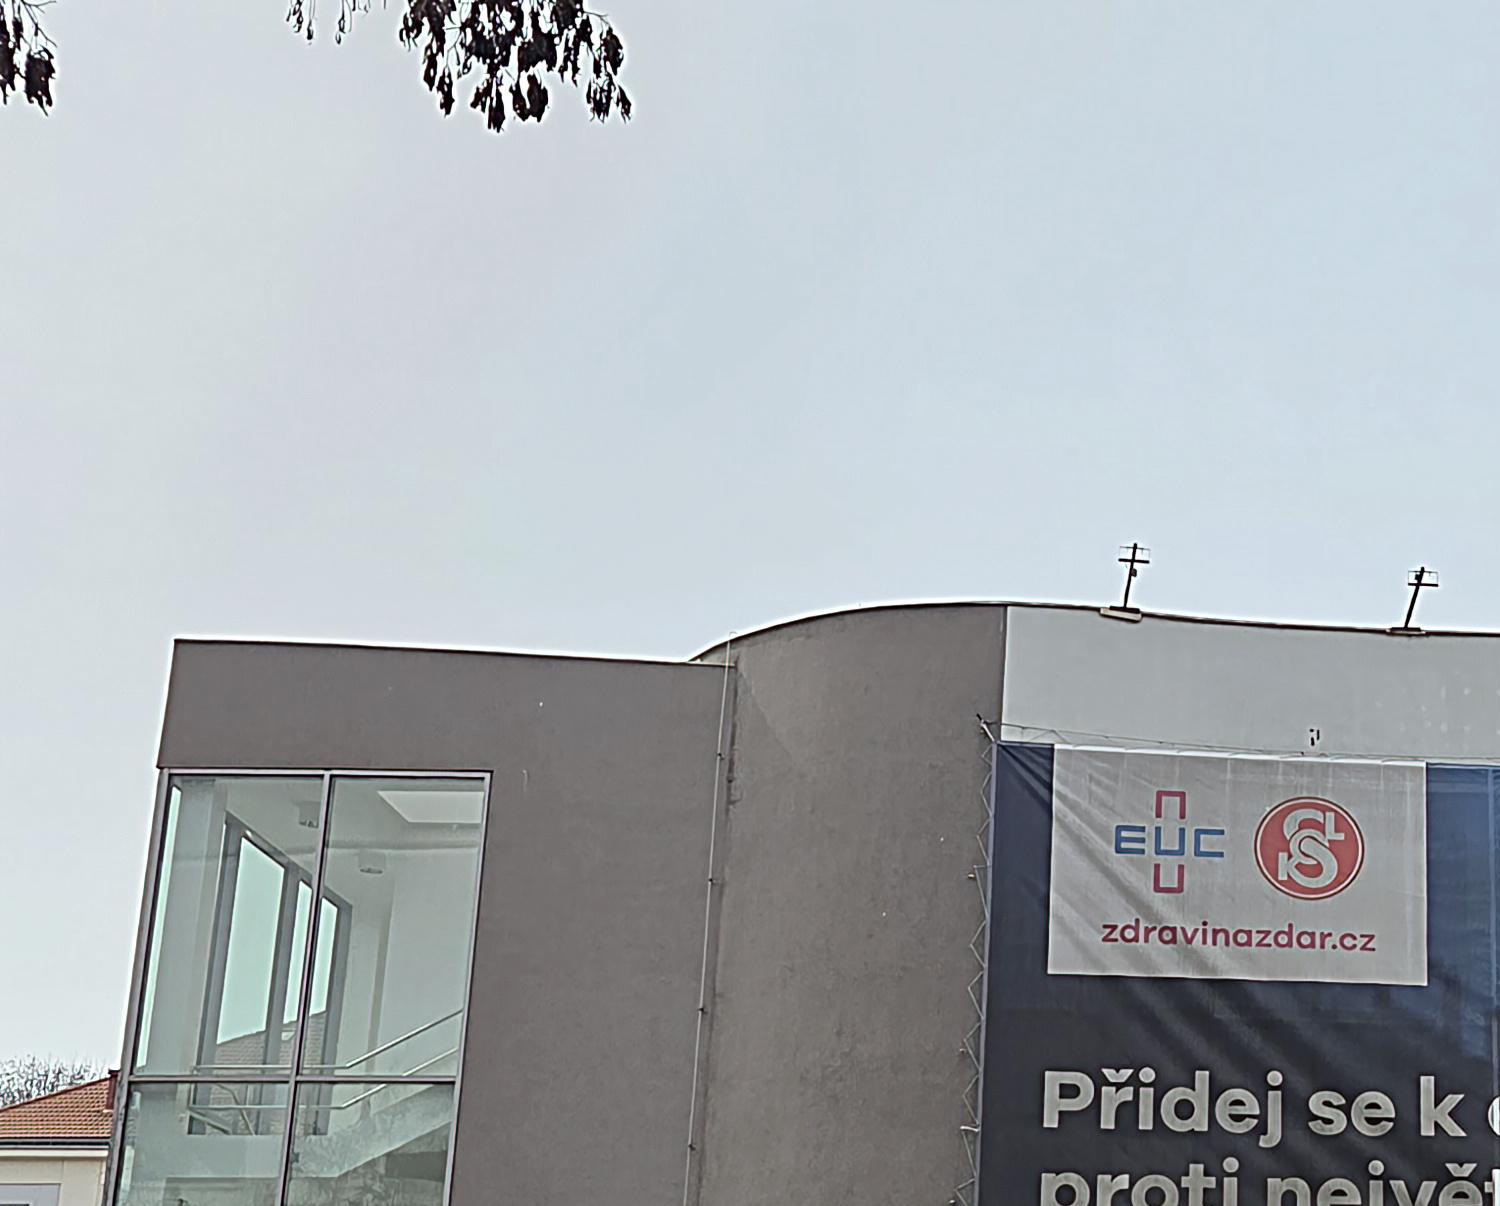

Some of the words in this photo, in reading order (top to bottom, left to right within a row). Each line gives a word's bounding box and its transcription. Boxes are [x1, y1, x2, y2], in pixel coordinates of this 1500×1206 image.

[1115, 825, 1225, 858] EUC
[1101, 918, 1376, 952] zdravinazdar.cz
[1043, 1067, 1284, 1148] Přidej
[1307, 1090, 1395, 1137] se
[1419, 1075, 1467, 1138] k
